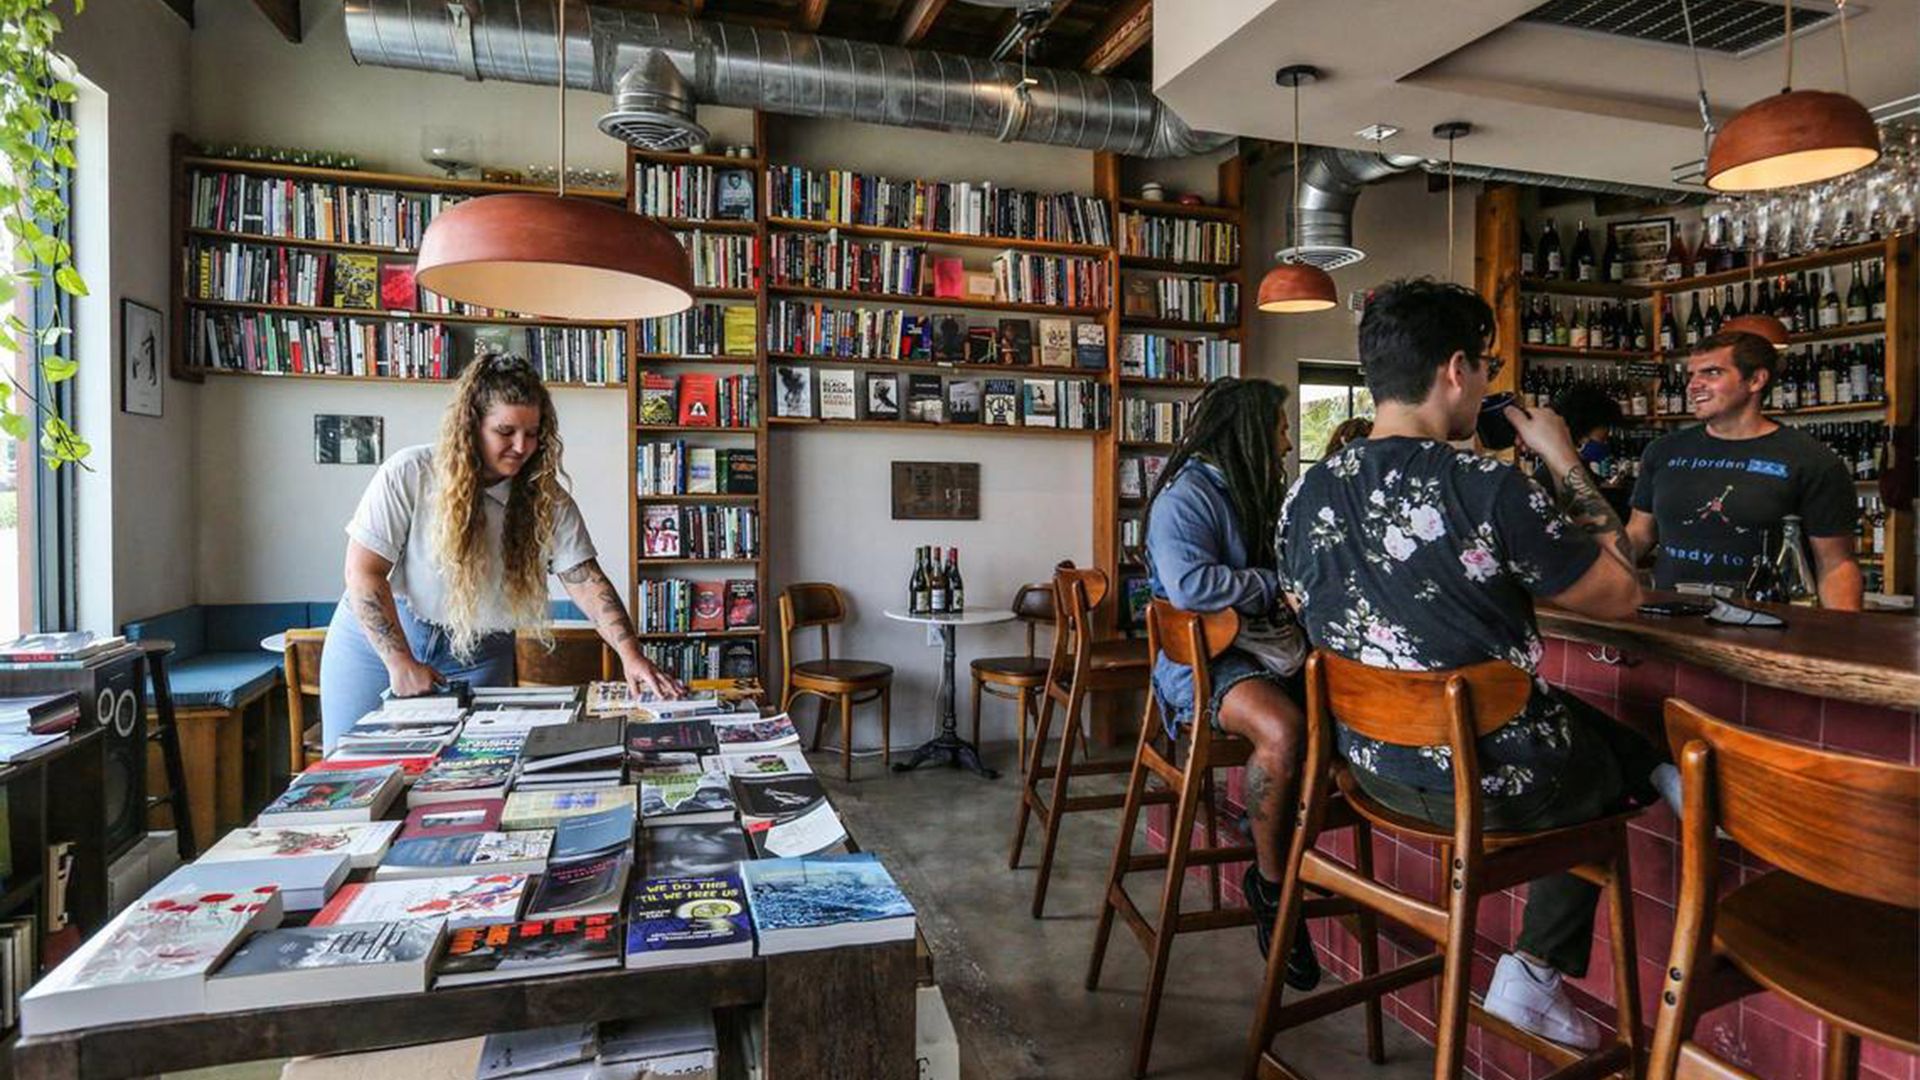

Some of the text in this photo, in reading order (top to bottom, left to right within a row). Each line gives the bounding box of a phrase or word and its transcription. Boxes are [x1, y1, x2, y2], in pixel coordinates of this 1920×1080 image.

[1668, 457, 1687, 468] air
[1691, 458, 1745, 470] jordan
[1723, 552, 1743, 566] to
[646, 881, 728, 893] WE DO THIS
[663, 892, 682, 900] WE
[687, 890, 718, 899] FREE
[721, 889, 739, 898] US
